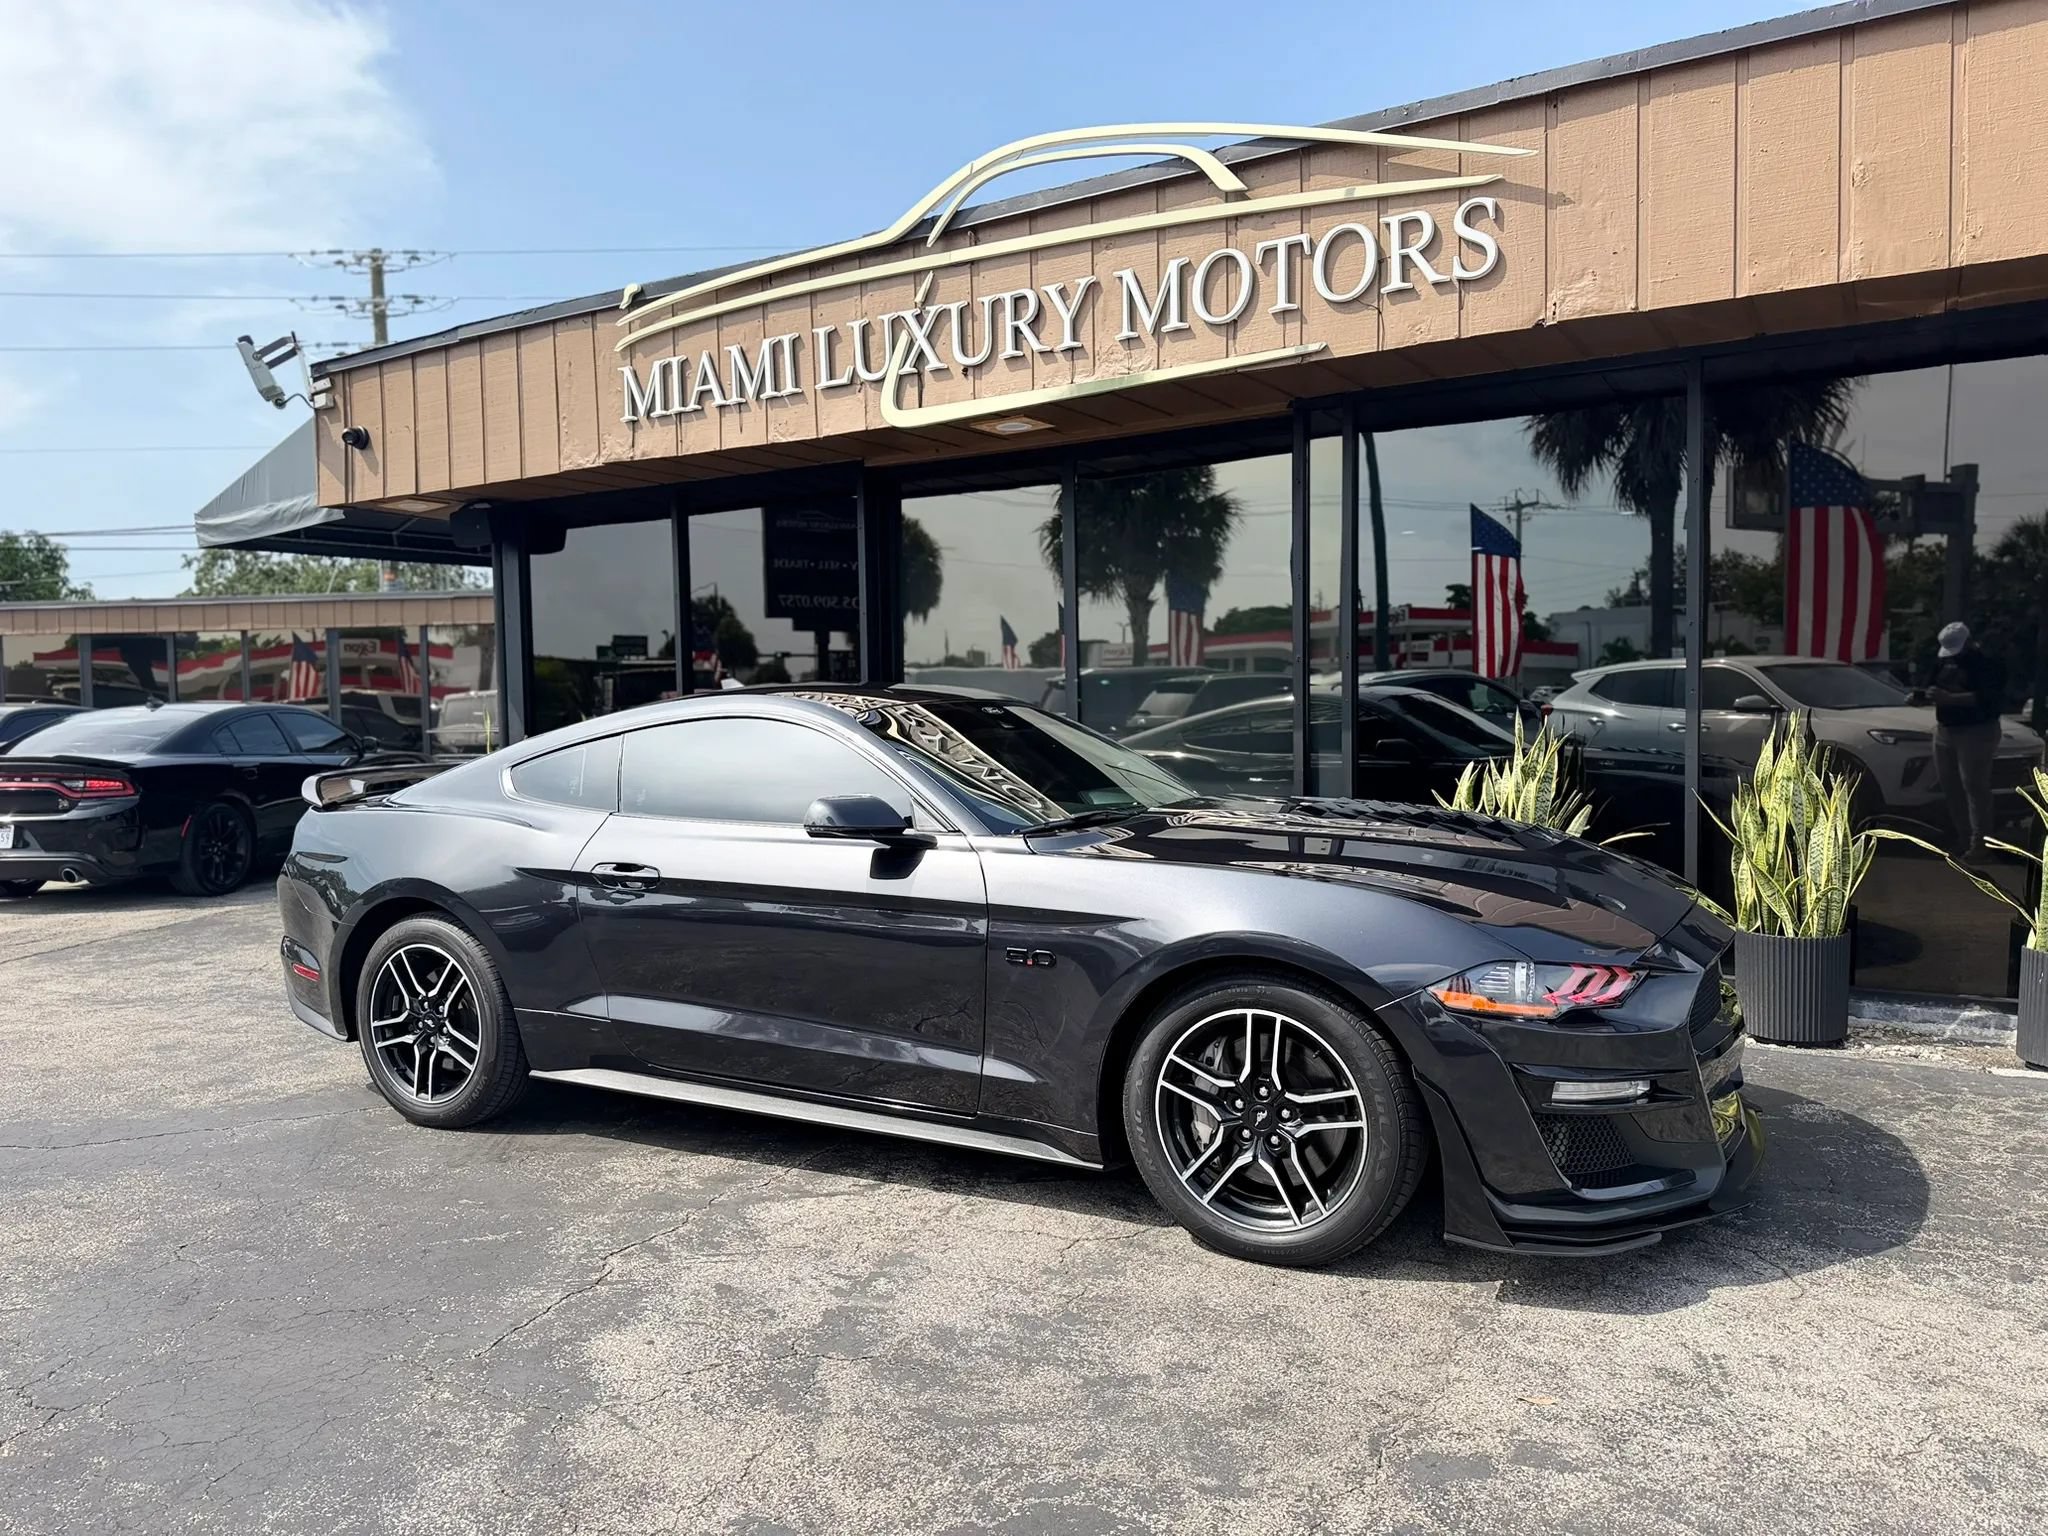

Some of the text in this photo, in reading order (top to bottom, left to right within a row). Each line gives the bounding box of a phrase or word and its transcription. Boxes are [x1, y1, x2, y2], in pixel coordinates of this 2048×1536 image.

[618, 197, 1499, 423] MIAMI LUXURY MOTORS
[1005, 946, 1057, 968] 5.0
